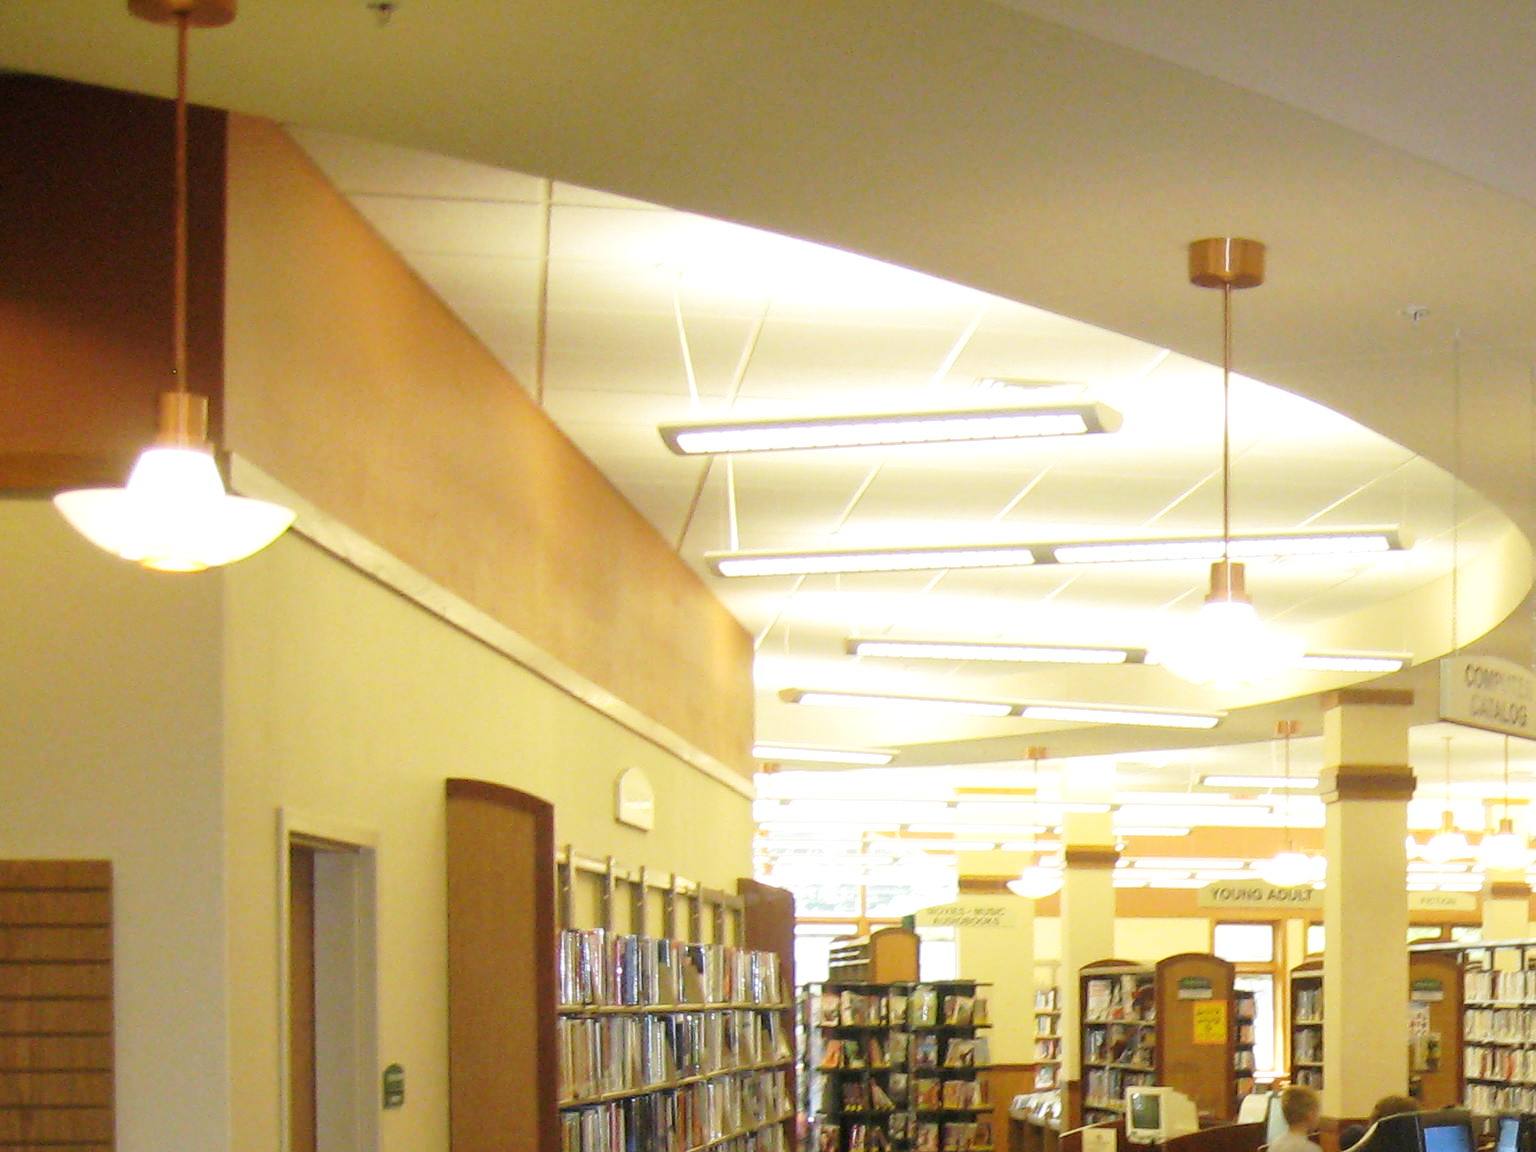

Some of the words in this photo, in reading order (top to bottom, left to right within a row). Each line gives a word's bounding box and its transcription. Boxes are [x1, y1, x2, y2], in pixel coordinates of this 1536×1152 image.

[1471, 693, 1528, 728] CATALOG
[1211, 887, 1263, 901] YOUNG
[1267, 888, 1315, 902] ADULT
